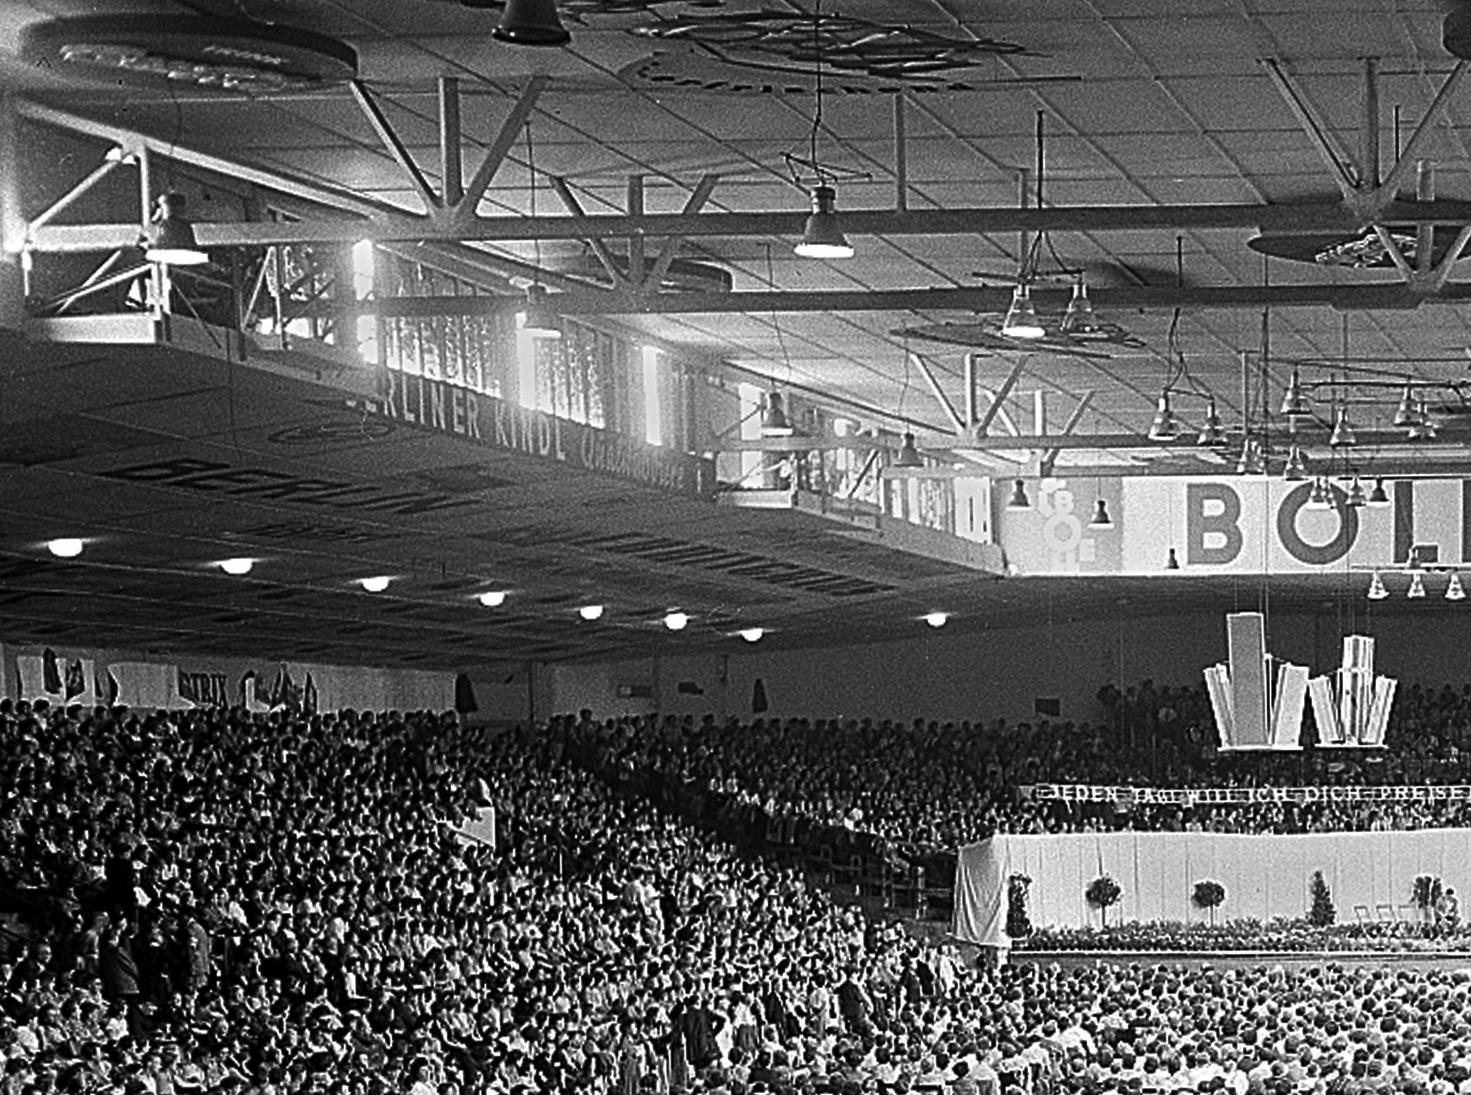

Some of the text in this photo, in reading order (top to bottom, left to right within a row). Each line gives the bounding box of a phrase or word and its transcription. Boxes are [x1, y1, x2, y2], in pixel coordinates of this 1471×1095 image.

[1053, 784, 1118, 802] JEDEN
[1248, 786, 1292, 802] ICH
[1304, 786, 1361, 801] DICH
